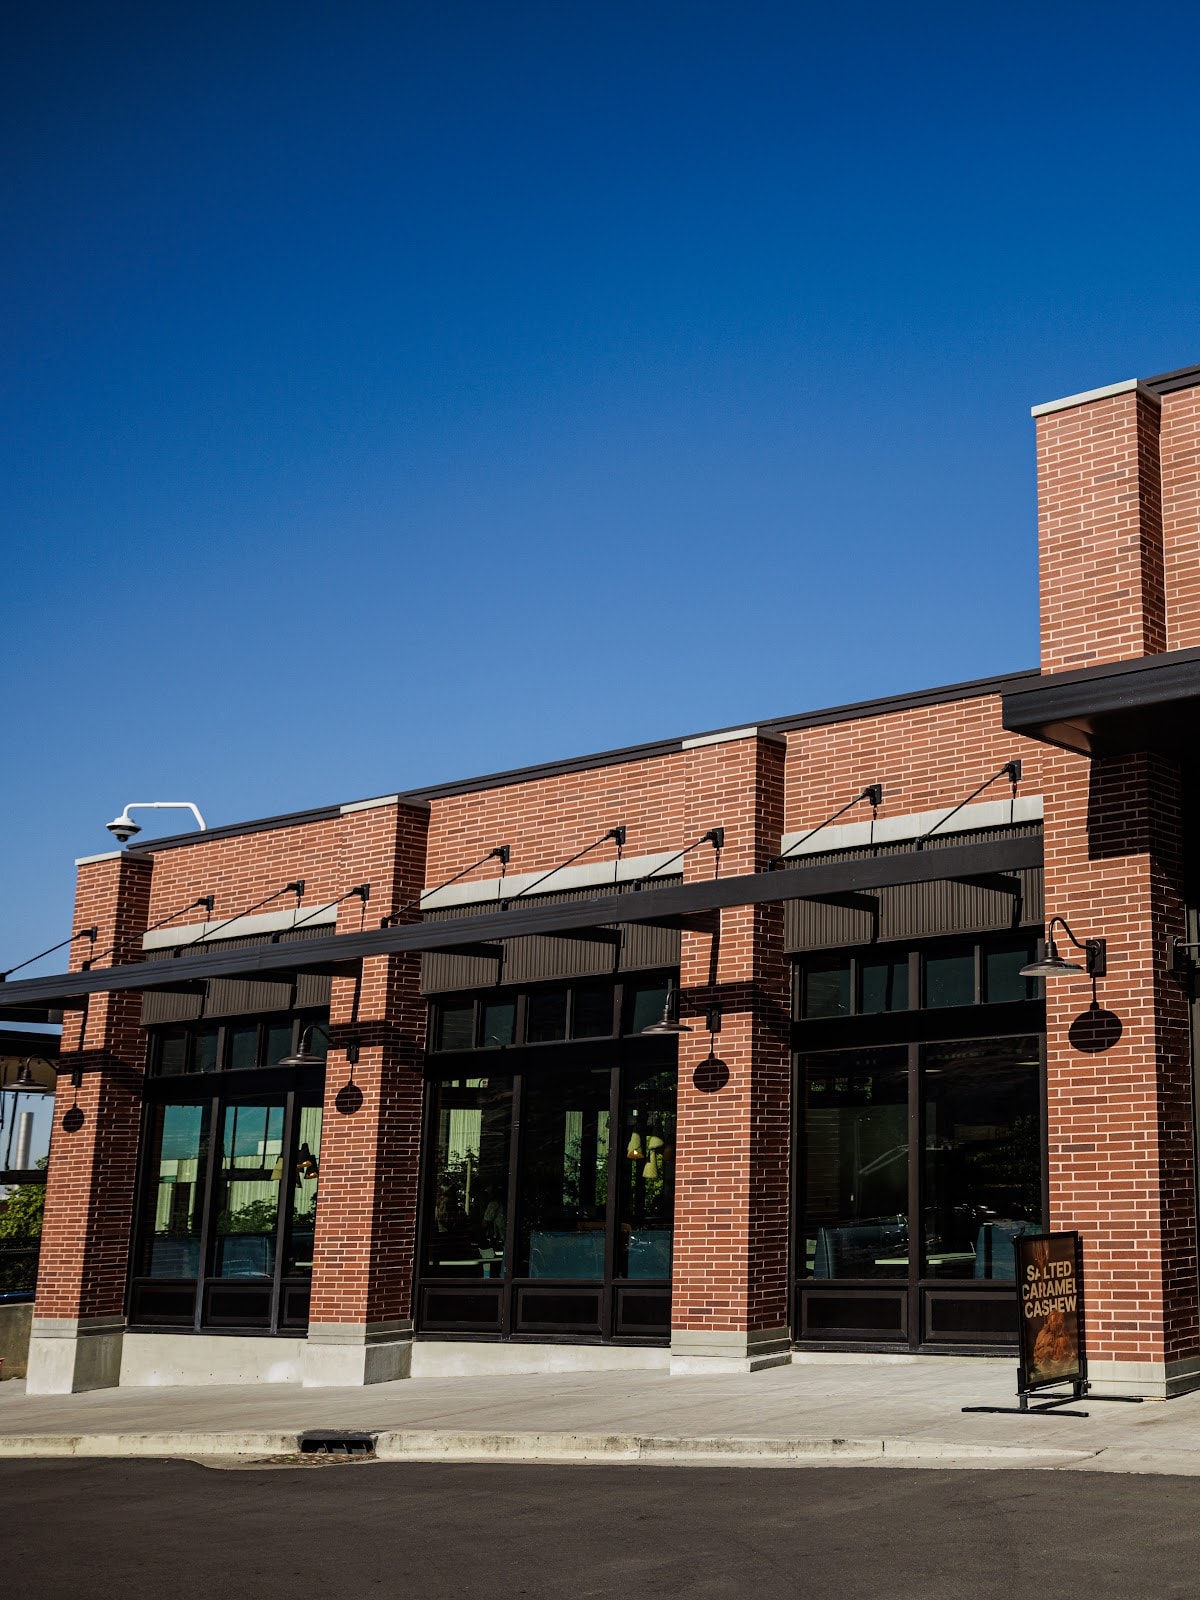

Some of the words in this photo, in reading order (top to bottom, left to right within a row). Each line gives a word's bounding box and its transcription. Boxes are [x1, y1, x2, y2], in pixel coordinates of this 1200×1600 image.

[1026, 1260, 1072, 1282] SALTED
[1022, 1277, 1077, 1301] CARAMEL
[1024, 1295, 1077, 1319] CASHEW
